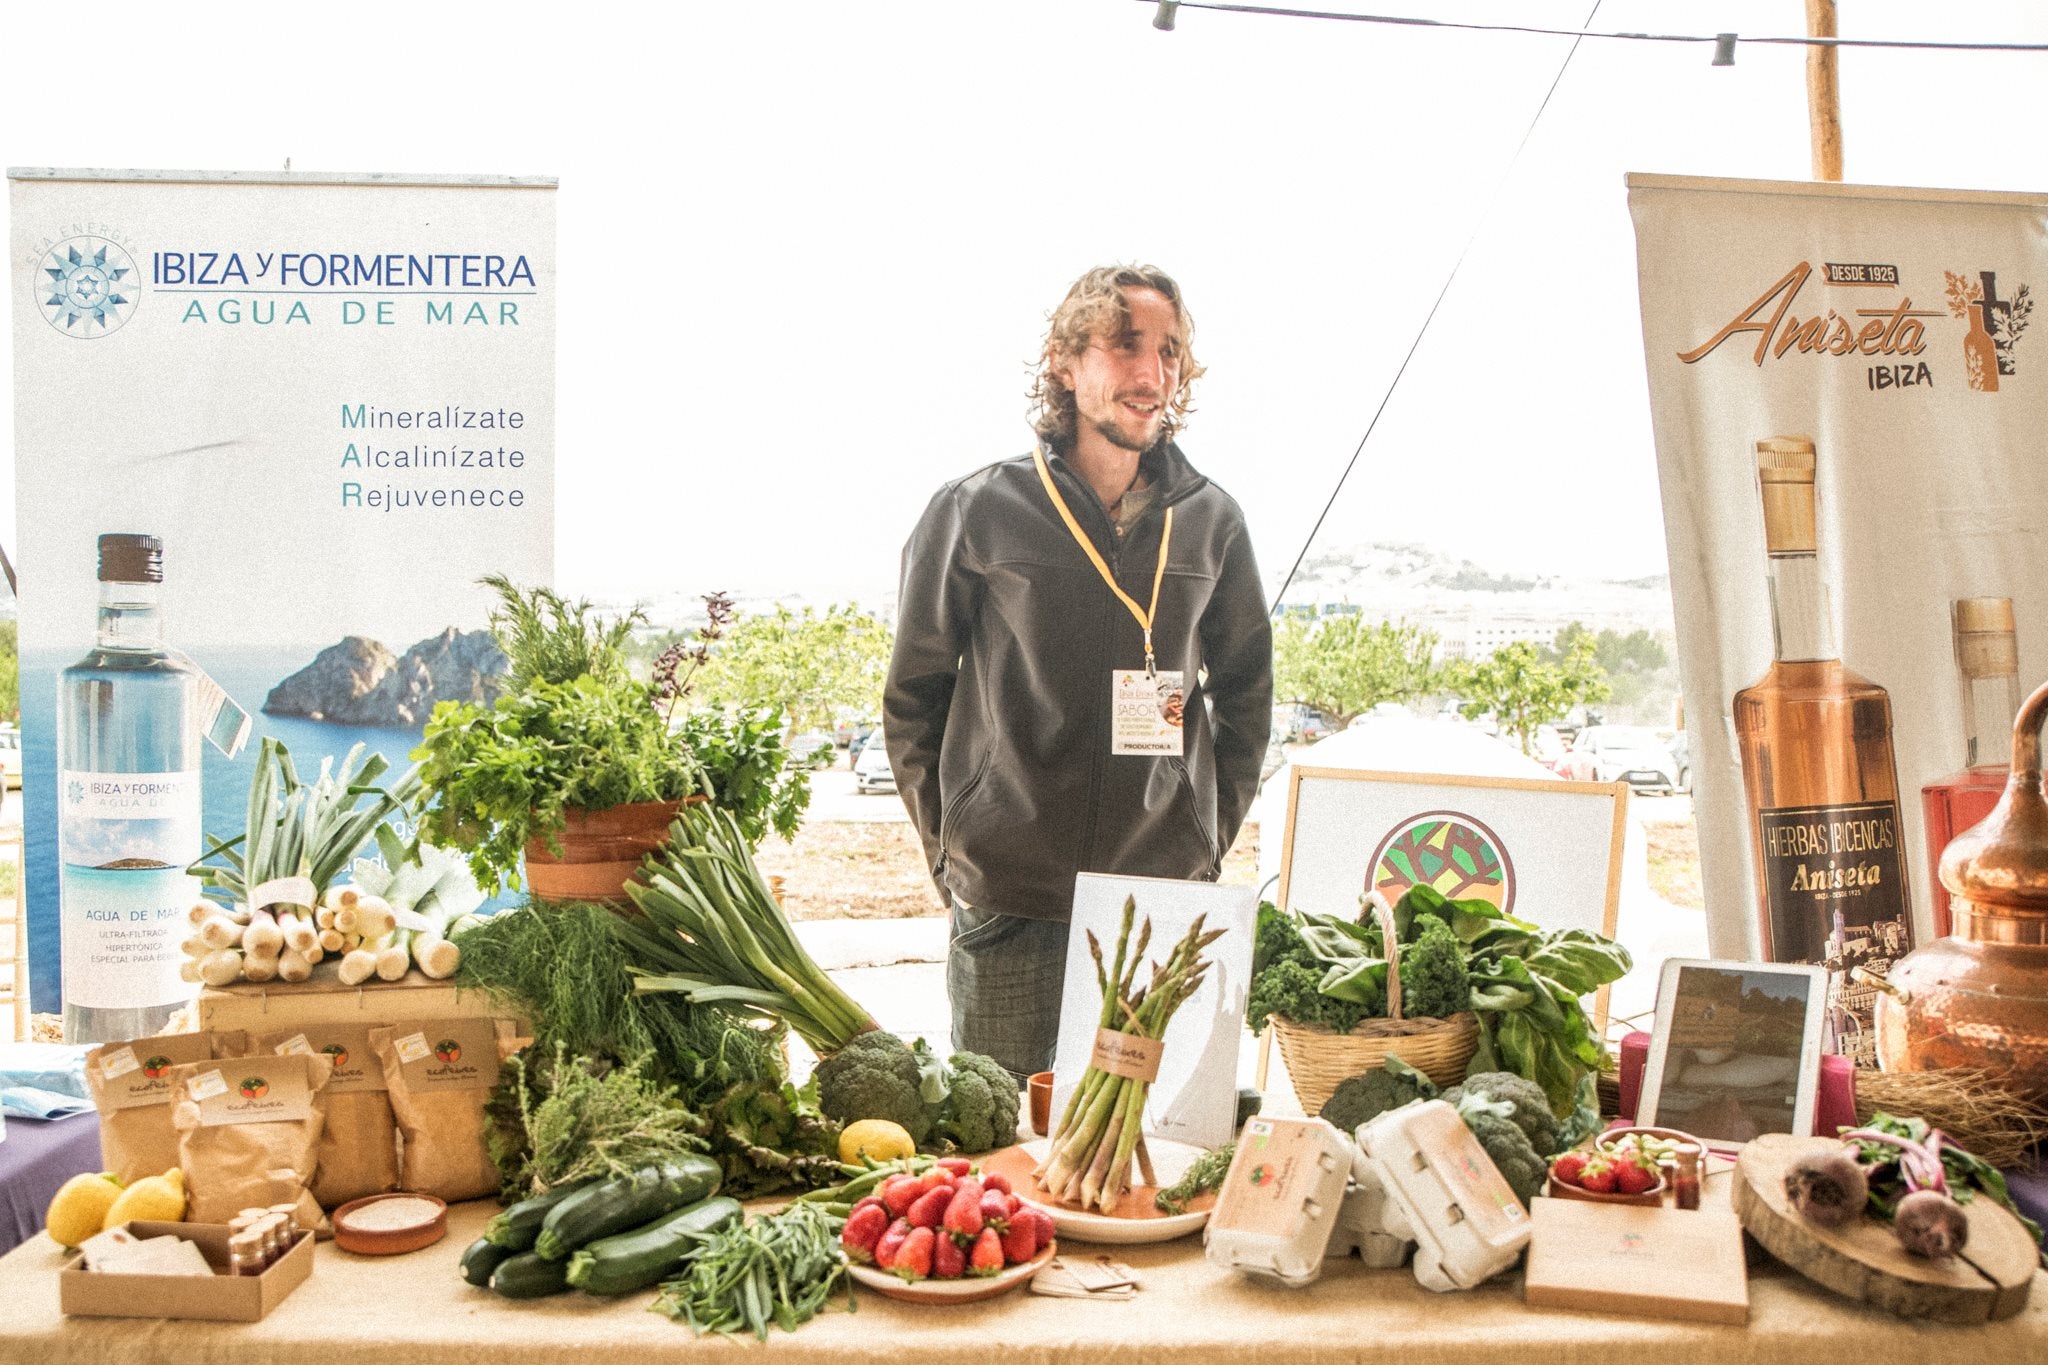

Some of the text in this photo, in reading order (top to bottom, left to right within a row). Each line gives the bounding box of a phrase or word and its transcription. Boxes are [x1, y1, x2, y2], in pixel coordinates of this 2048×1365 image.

[154, 252, 249, 285] IBIZA
[281, 253, 536, 288] FORMENTERA
[1831, 265, 1895, 282] DESDE 1925
[182, 299, 519, 326] AGUA DE MAR
[1676, 260, 1948, 367] Aniseta
[1867, 361, 1933, 391] IBIZA
[341, 403, 525, 429] Mineralízate
[340, 443, 525, 468] Alcalinízate
[341, 481, 525, 513] Rejuvenece
[90, 782, 122, 795] IBIZA
[98, 798, 141, 808] AGUA
[1767, 818, 1893, 858] HIERBAS IBICENCAS
[1790, 860, 1881, 892] Aniseta
[86, 910, 121, 922] AGUA
[130, 910, 149, 921] DE
[90, 954, 129, 964] ESPECIAL
